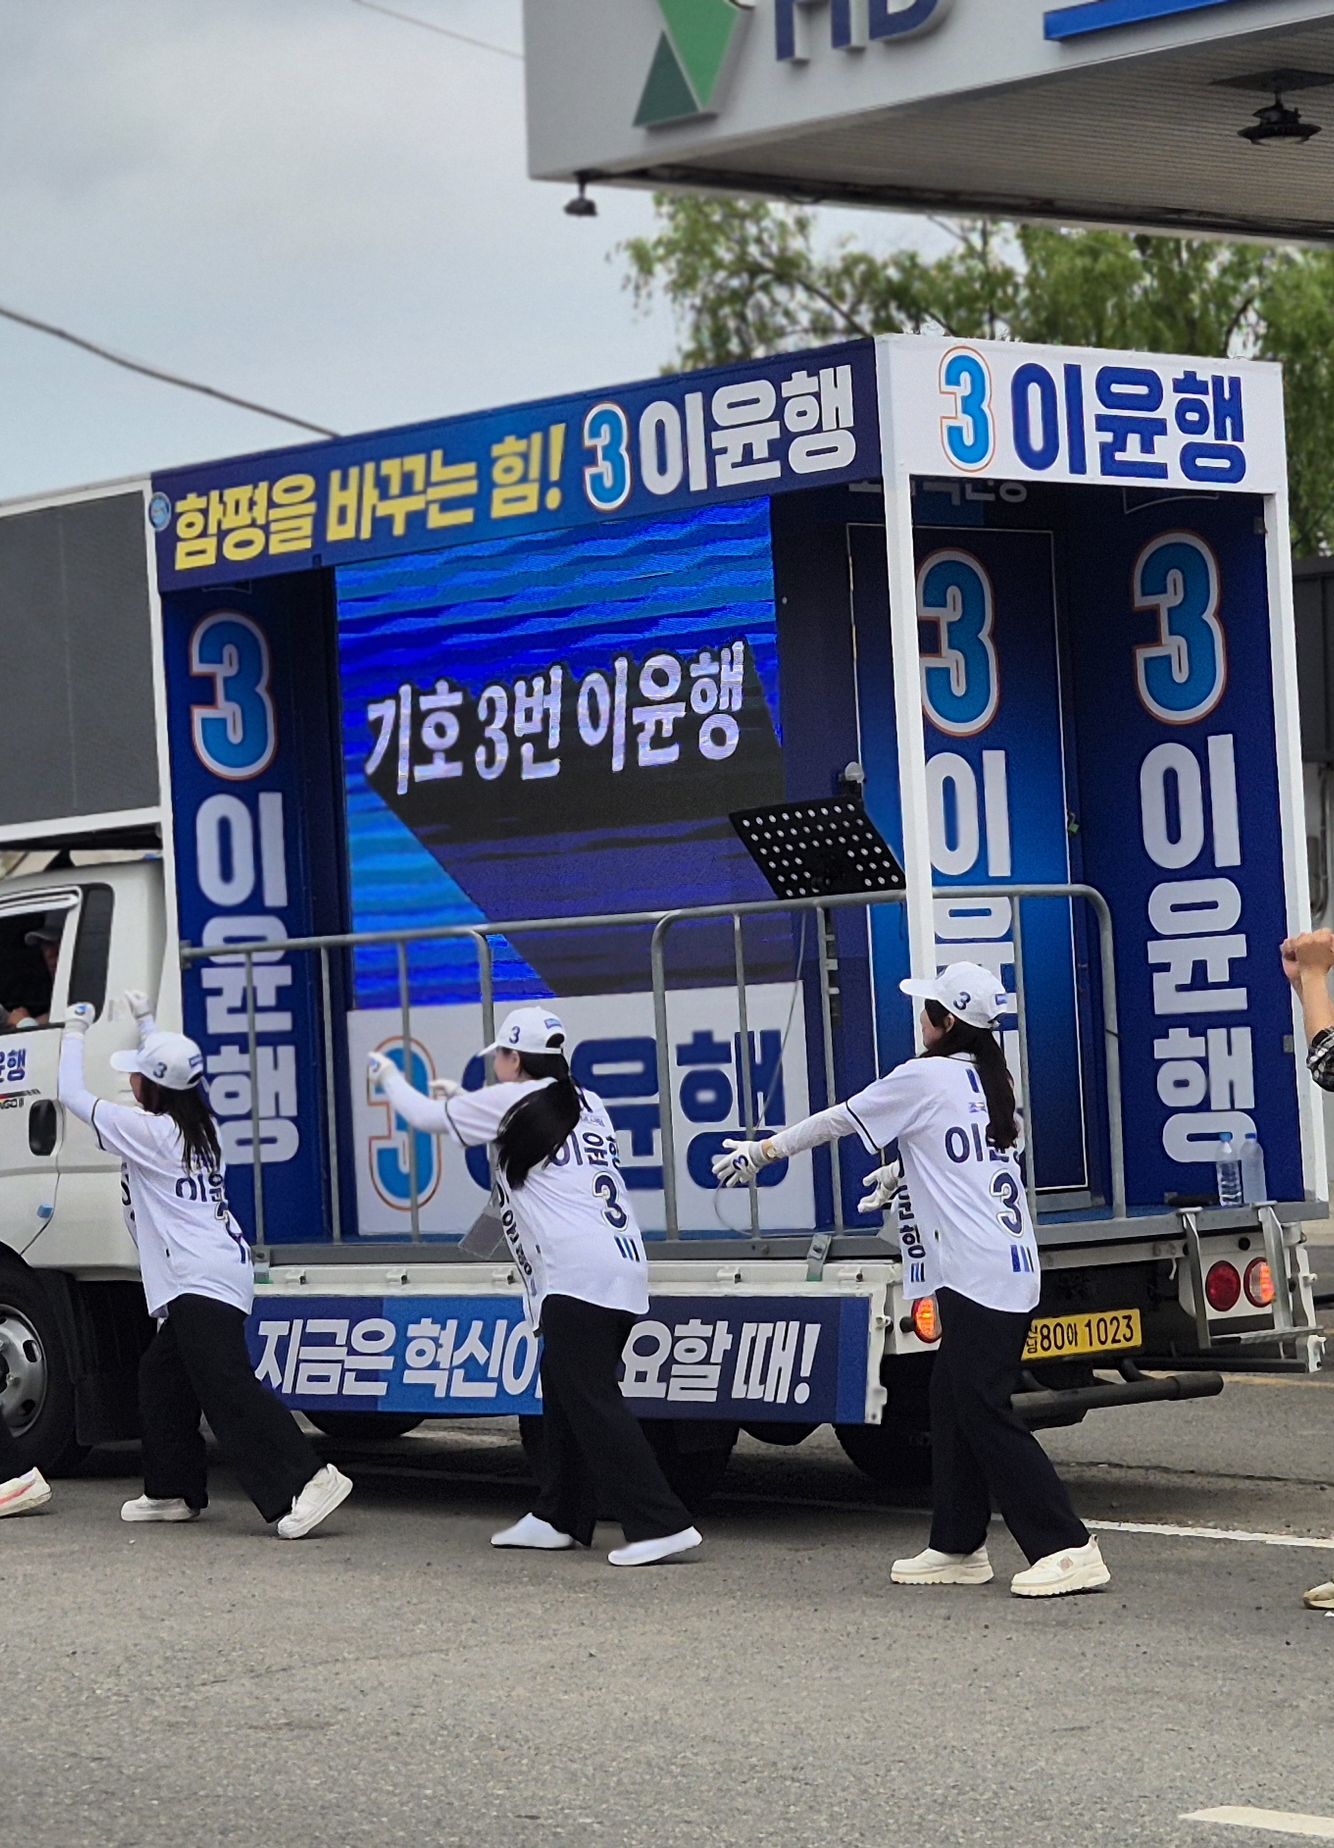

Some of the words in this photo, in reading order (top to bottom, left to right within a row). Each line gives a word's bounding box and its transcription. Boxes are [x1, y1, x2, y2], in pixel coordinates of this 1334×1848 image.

[174, 474, 316, 571] 함평을
[327, 450, 479, 543] 바꾸는
[491, 423, 567, 519] 힘!
[583, 402, 632, 512] 3
[638, 364, 857, 492] 이윤행
[939, 346, 996, 473] 3
[1011, 362, 1246, 483] 이윤행
[918, 547, 1000, 738] 3
[1132, 529, 1228, 726] 3
[189, 608, 278, 781] 3
[366, 681, 464, 795] 기호
[475, 664, 562, 782] 3번
[575, 641, 745, 774] 이윤행
[954, 992, 971, 1010] 3
[1139, 733, 1259, 1165] 이윤행
[153, 1062, 167, 1079] 3
[510, 1026, 521, 1044] 3
[593, 1171, 629, 1232] 3
[989, 1169, 1024, 1239] 3
[255, 1318, 396, 1395] 지금은
[731, 1321, 821, 1404] 때!
[1085, 1314, 1134, 1347] 1023
